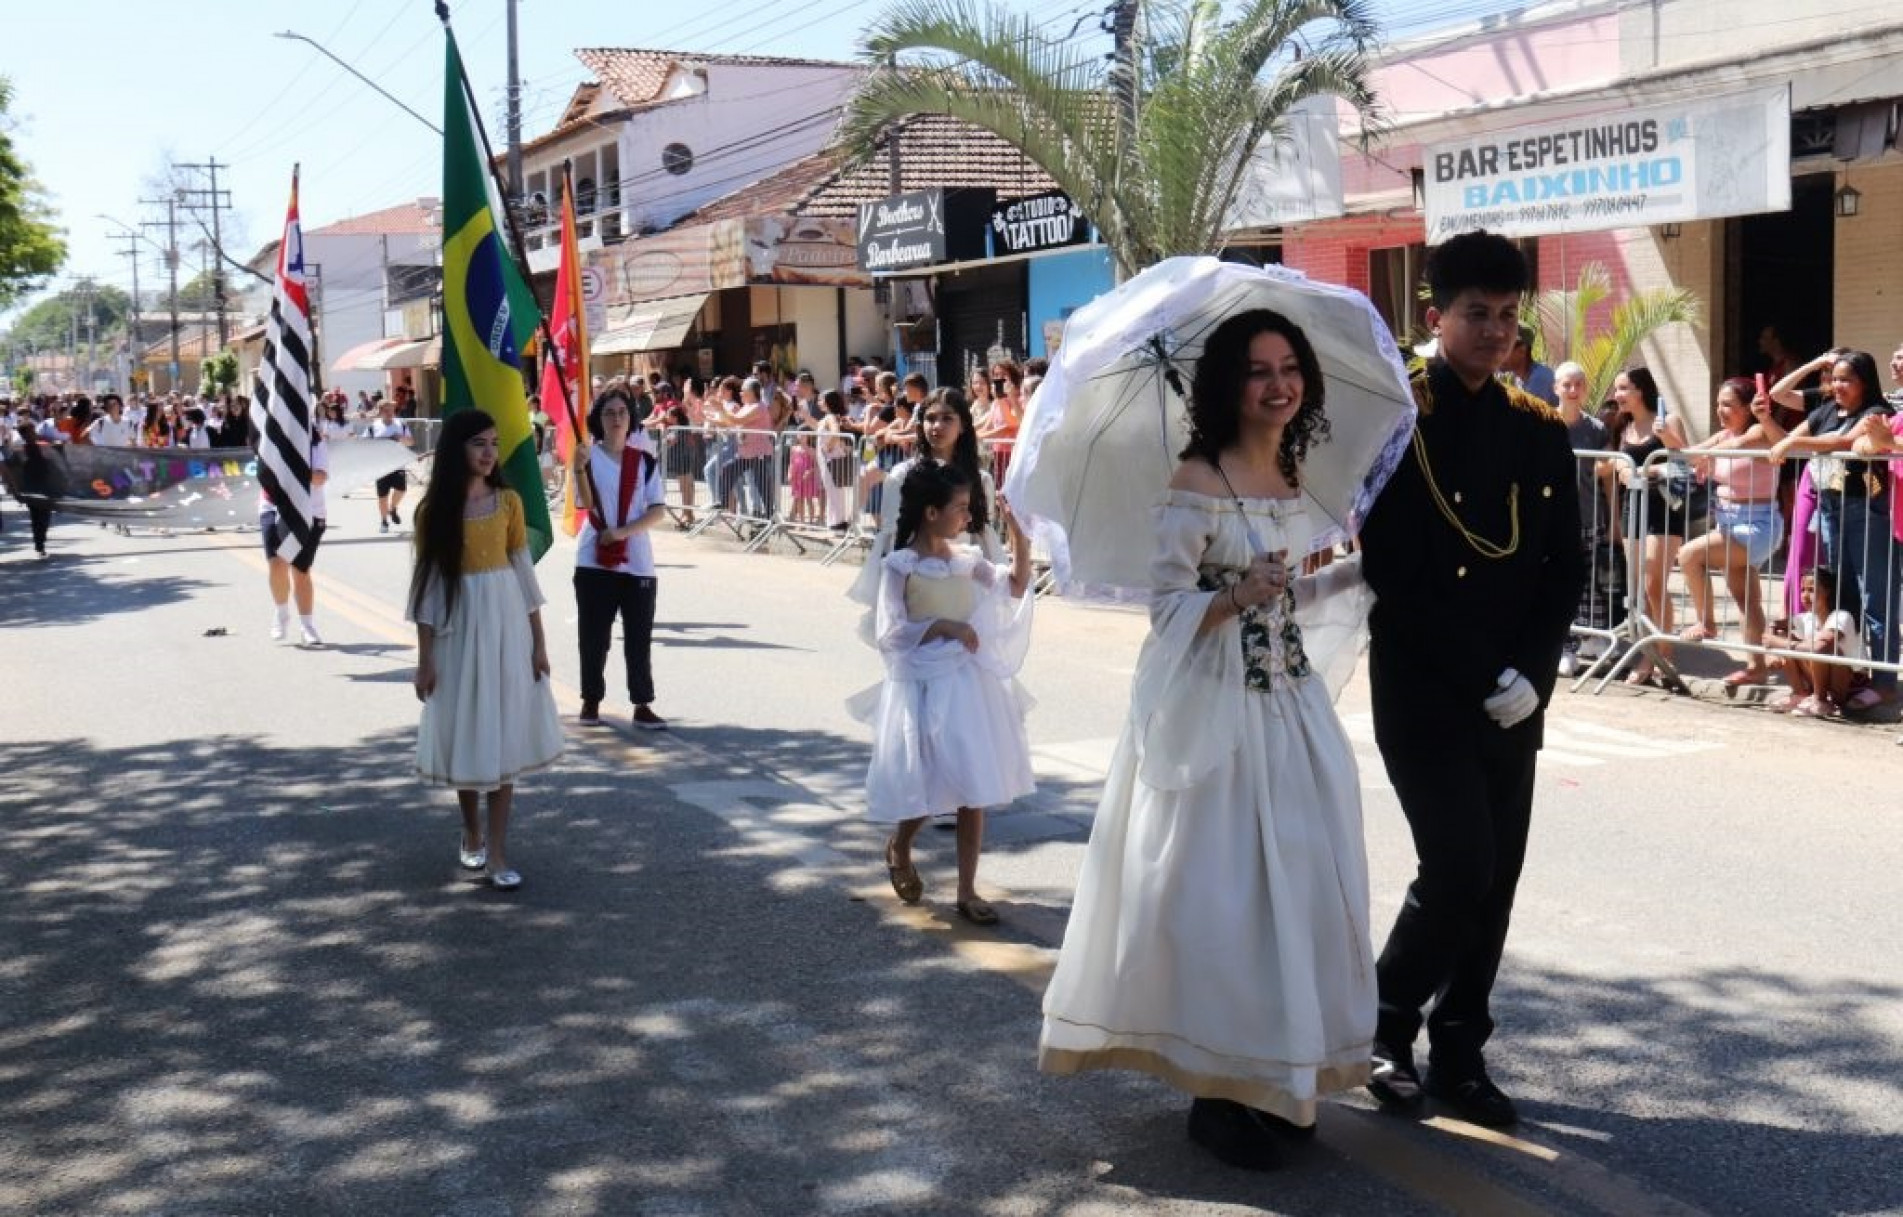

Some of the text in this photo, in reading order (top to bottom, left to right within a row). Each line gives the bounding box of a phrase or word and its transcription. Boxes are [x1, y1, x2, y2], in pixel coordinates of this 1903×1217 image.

[1435, 119, 1659, 183] BAR ESPETINHOS
[1464, 157, 1682, 209] BAIXINHO
[866, 238, 931, 269] Barbearia
[1009, 215, 1068, 250] TATTOO
